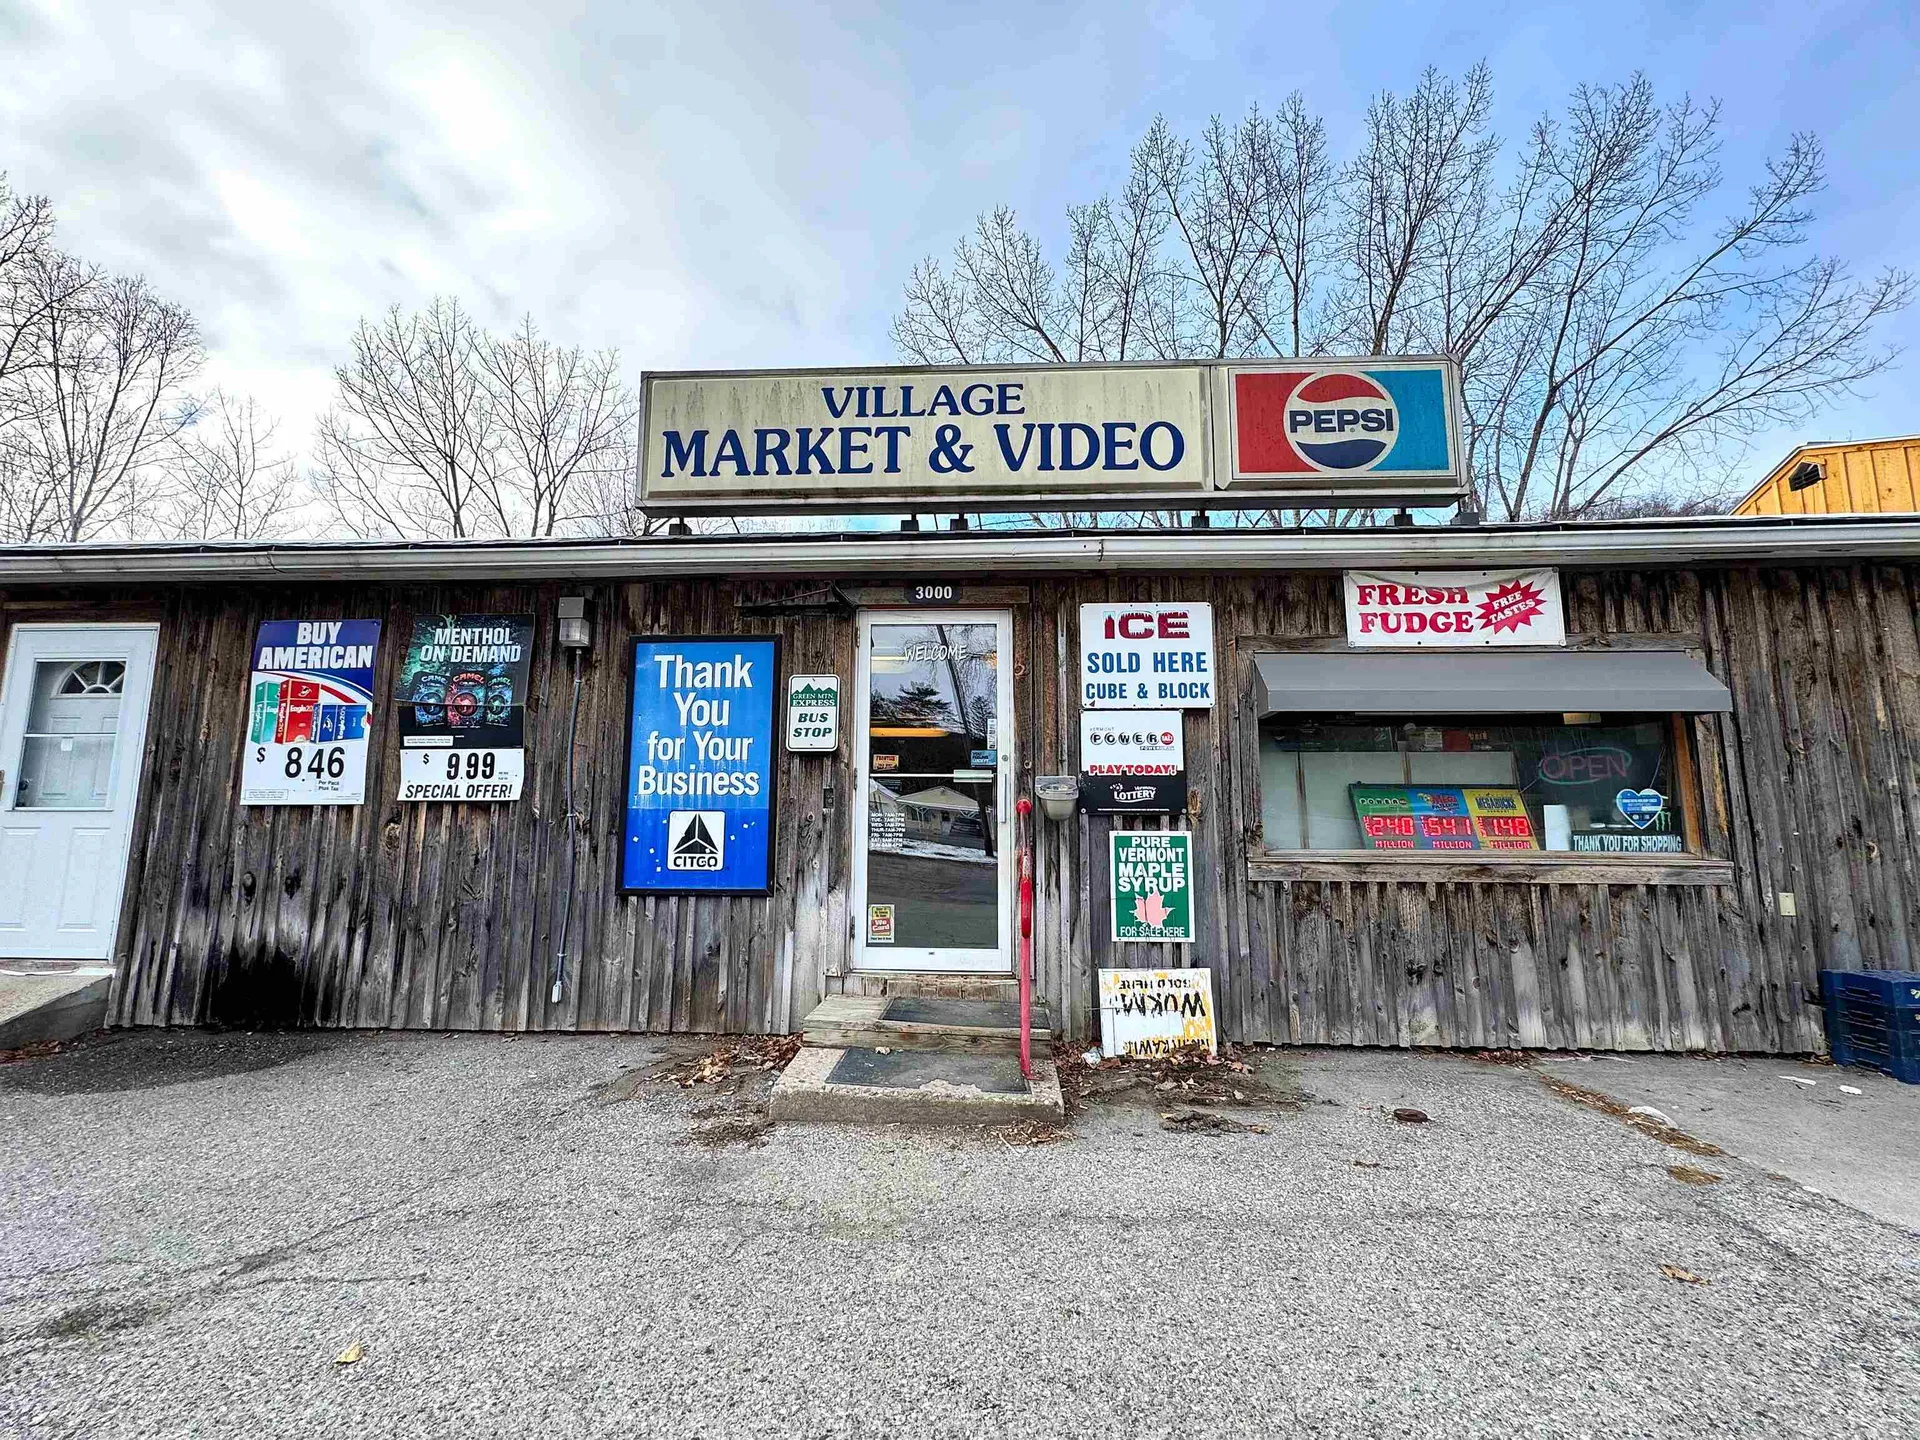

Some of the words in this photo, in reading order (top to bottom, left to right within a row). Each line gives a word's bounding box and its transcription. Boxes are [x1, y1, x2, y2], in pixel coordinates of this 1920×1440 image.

[821, 383, 1026, 418] VILLAGE
[1289, 409, 1394, 433] PEPSI
[660, 426, 911, 477] MARKET
[928, 423, 975, 473] &
[993, 421, 1185, 472] VIDEO
[915, 586, 952, 599] 3000
[1357, 584, 1470, 605] FRESH
[1491, 591, 1523, 610] FREE
[1488, 598, 1536, 624] TASTES
[1102, 611, 1190, 639] ICE
[1359, 611, 1474, 634] FUDGE
[296, 621, 343, 645] BUY
[434, 627, 513, 646] MENTHOL
[257, 645, 374, 670] AMERICAN
[419, 645, 448, 663] ON
[450, 644, 522, 663] DEMAND
[904, 644, 968, 661] WELCOME
[654, 654, 754, 688] Thank
[1087, 652, 1141, 673] SOLD
[1153, 652, 1208, 673] HERE
[453, 673, 485, 683] CAMEL
[1085, 683, 1127, 699] CUBE
[1137, 683, 1148, 699] &
[1158, 682, 1210, 699] BLOCK
[672, 692, 731, 726] You
[798, 712, 829, 722] BUS
[793, 727, 832, 737] STOP
[647, 731, 685, 760] for
[692, 731, 754, 760] Your
[256, 747, 266, 763] $
[284, 746, 346, 782] 8.46
[423, 753, 430, 765] $
[446, 752, 496, 780] 9.99
[1089, 765, 1122, 774] PLAY
[1125, 765, 1176, 775] TODAY!
[1543, 755, 1627, 779] OPEN
[637, 764, 760, 796] Business
[404, 784, 463, 799] SPECIAL
[465, 784, 513, 799] OFFER!
[1114, 790, 1156, 800] LOTTERY
[1372, 817, 1414, 836] 240
[1428, 817, 1471, 836] 541
[1131, 837, 1171, 848] PURE
[1375, 840, 1414, 849] MILLION
[1432, 840, 1472, 849] MILLION
[1490, 840, 1530, 849] MILLION
[1573, 836, 1601, 852] THANK
[1603, 836, 1620, 852] YOU
[1622, 836, 1639, 851] FOR
[1640, 835, 1682, 852] SHOPPING
[673, 855, 718, 868] CITGO
[1118, 848, 1185, 863] VERMONT
[1118, 863, 1185, 879] MAPLE
[1118, 878, 1186, 893] SYRUP
[1120, 926, 1137, 937] FOR
[1138, 926, 1162, 937] SALE
[1163, 926, 1185, 937] HERE
